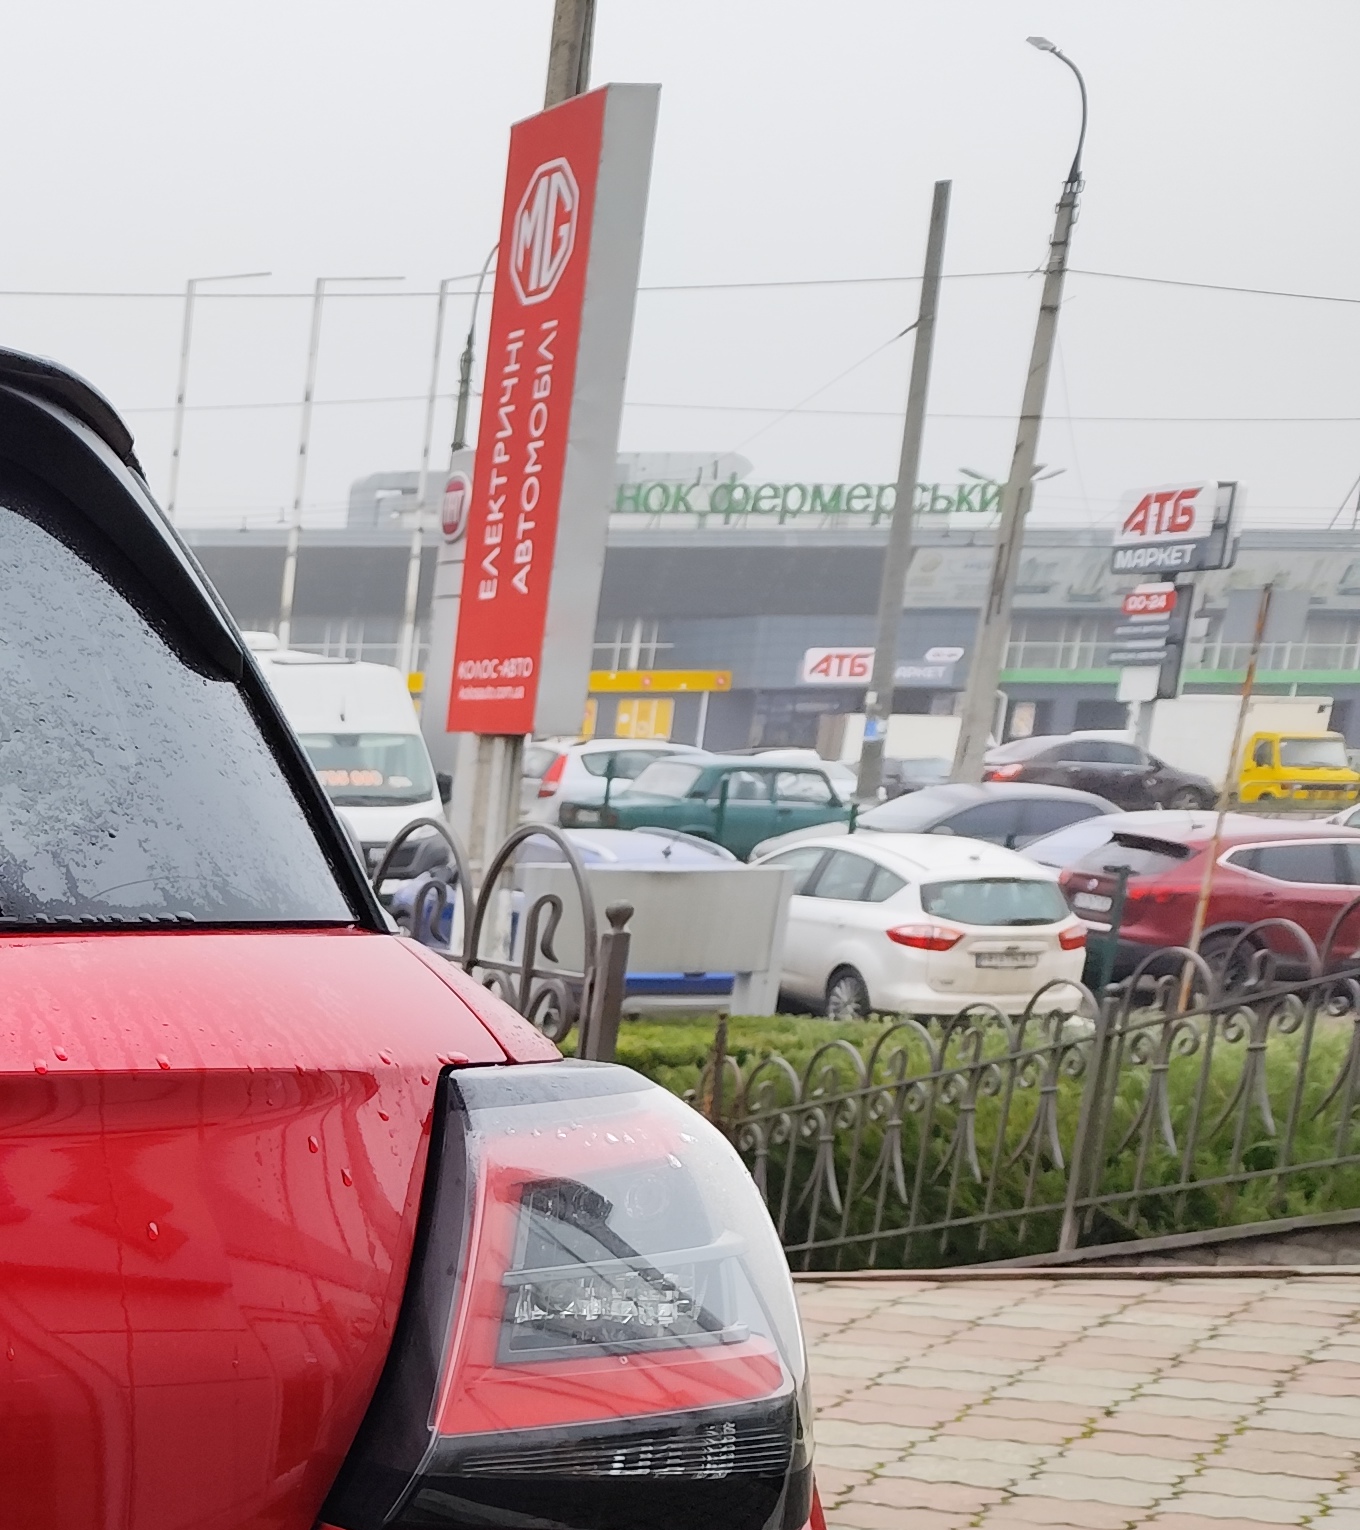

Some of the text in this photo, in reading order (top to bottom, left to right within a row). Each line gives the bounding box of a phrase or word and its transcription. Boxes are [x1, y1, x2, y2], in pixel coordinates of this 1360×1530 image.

[516, 171, 574, 292] MG
[478, 329, 525, 600] ЕЛЕКТРИЧНІ
[511, 319, 558, 594] АВТОМОБІЛІ
[616, 472, 1003, 526] нок фермерськи
[1122, 487, 1204, 536] АТБ
[1114, 544, 1196, 569] МАРКЕТ
[809, 653, 874, 677] АТБ
[895, 666, 947, 679] АРКЕТ
